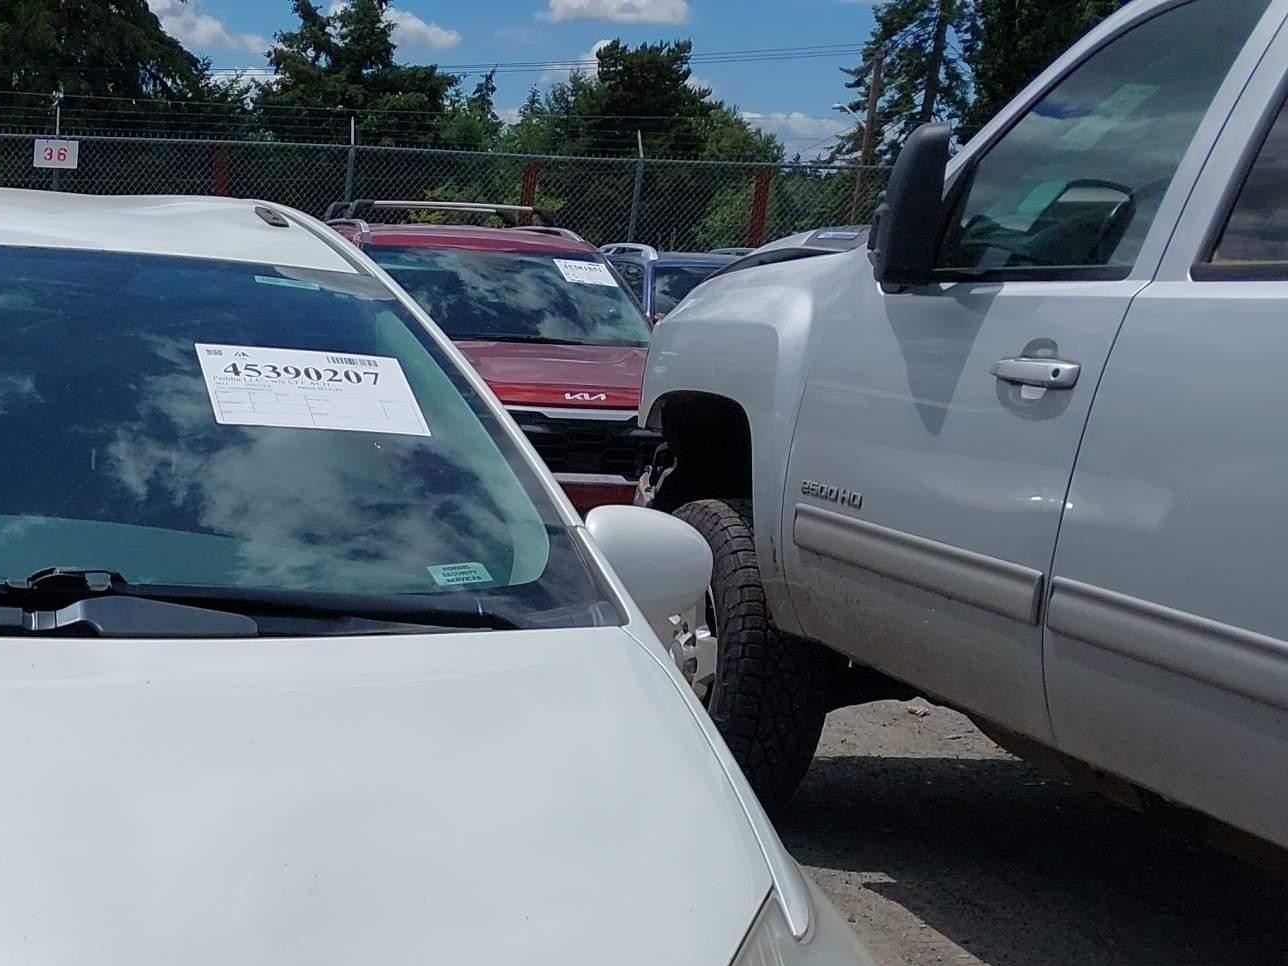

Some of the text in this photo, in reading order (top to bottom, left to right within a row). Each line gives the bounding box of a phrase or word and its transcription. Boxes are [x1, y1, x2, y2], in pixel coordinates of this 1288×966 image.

[43, 147, 68, 162] 36
[223, 362, 379, 385] 45390207
[564, 392, 607, 401] KIA
[801, 480, 863, 510] 2500 HD
